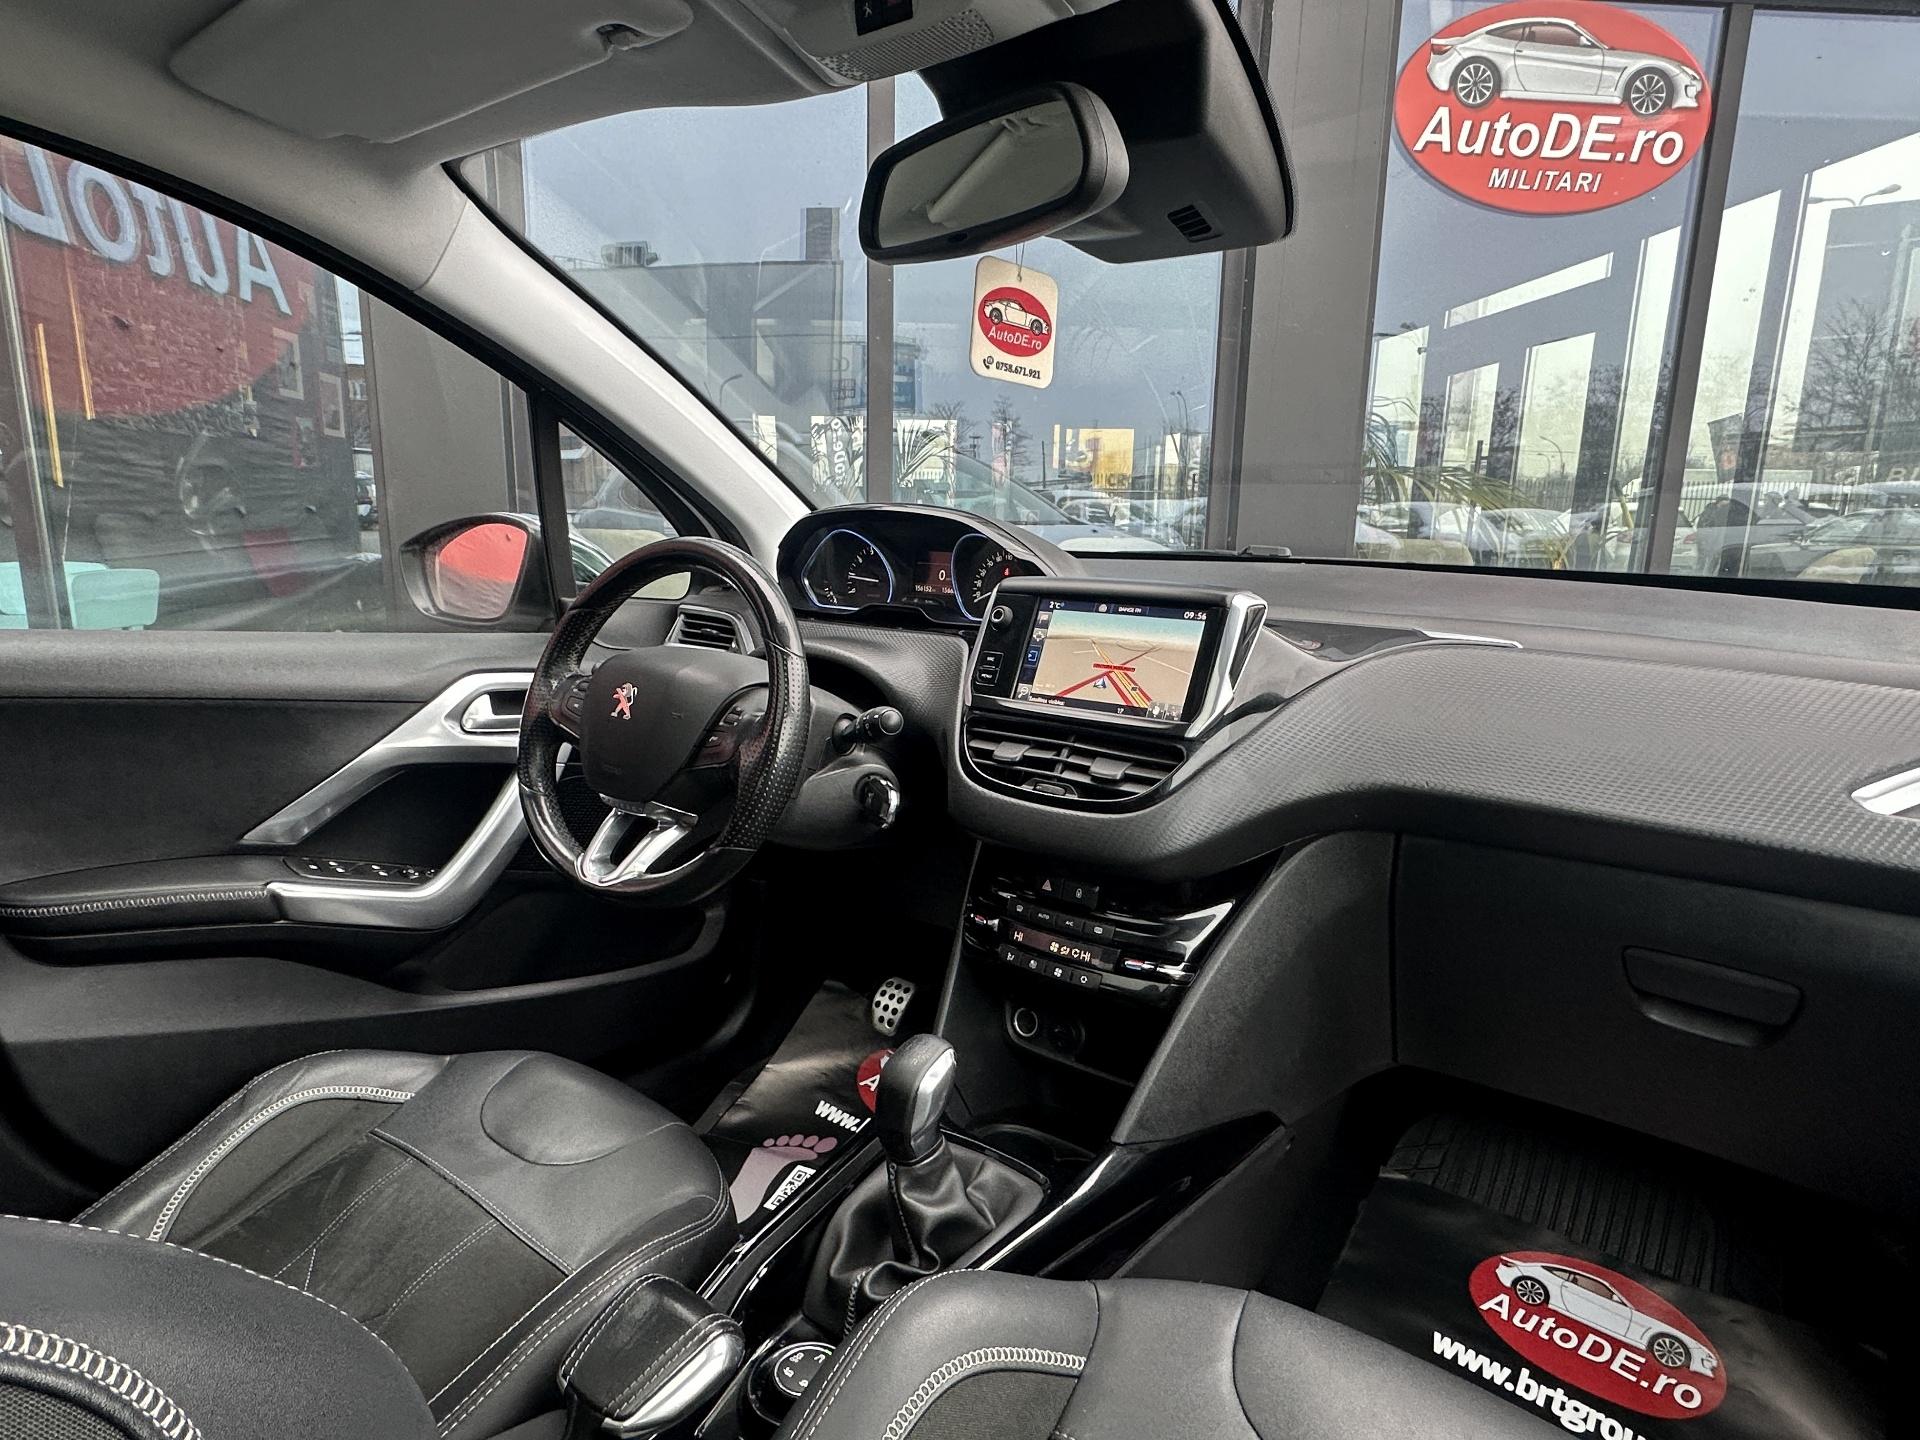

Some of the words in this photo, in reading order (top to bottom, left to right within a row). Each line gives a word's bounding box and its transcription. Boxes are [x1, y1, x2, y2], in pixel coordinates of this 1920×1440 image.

[1413, 106, 1684, 165] AutoDE.ro
[1488, 168, 1602, 192] MILITARI
[988, 326, 1041, 350] AutoDE.ro
[996, 361, 1041, 379] 0758.671.921
[1184, 611, 1207, 620] 09:56
[1013, 930, 1023, 942] HI
[1080, 951, 1091, 962] HI
[1479, 1293, 1702, 1409] AutoDE.ro
